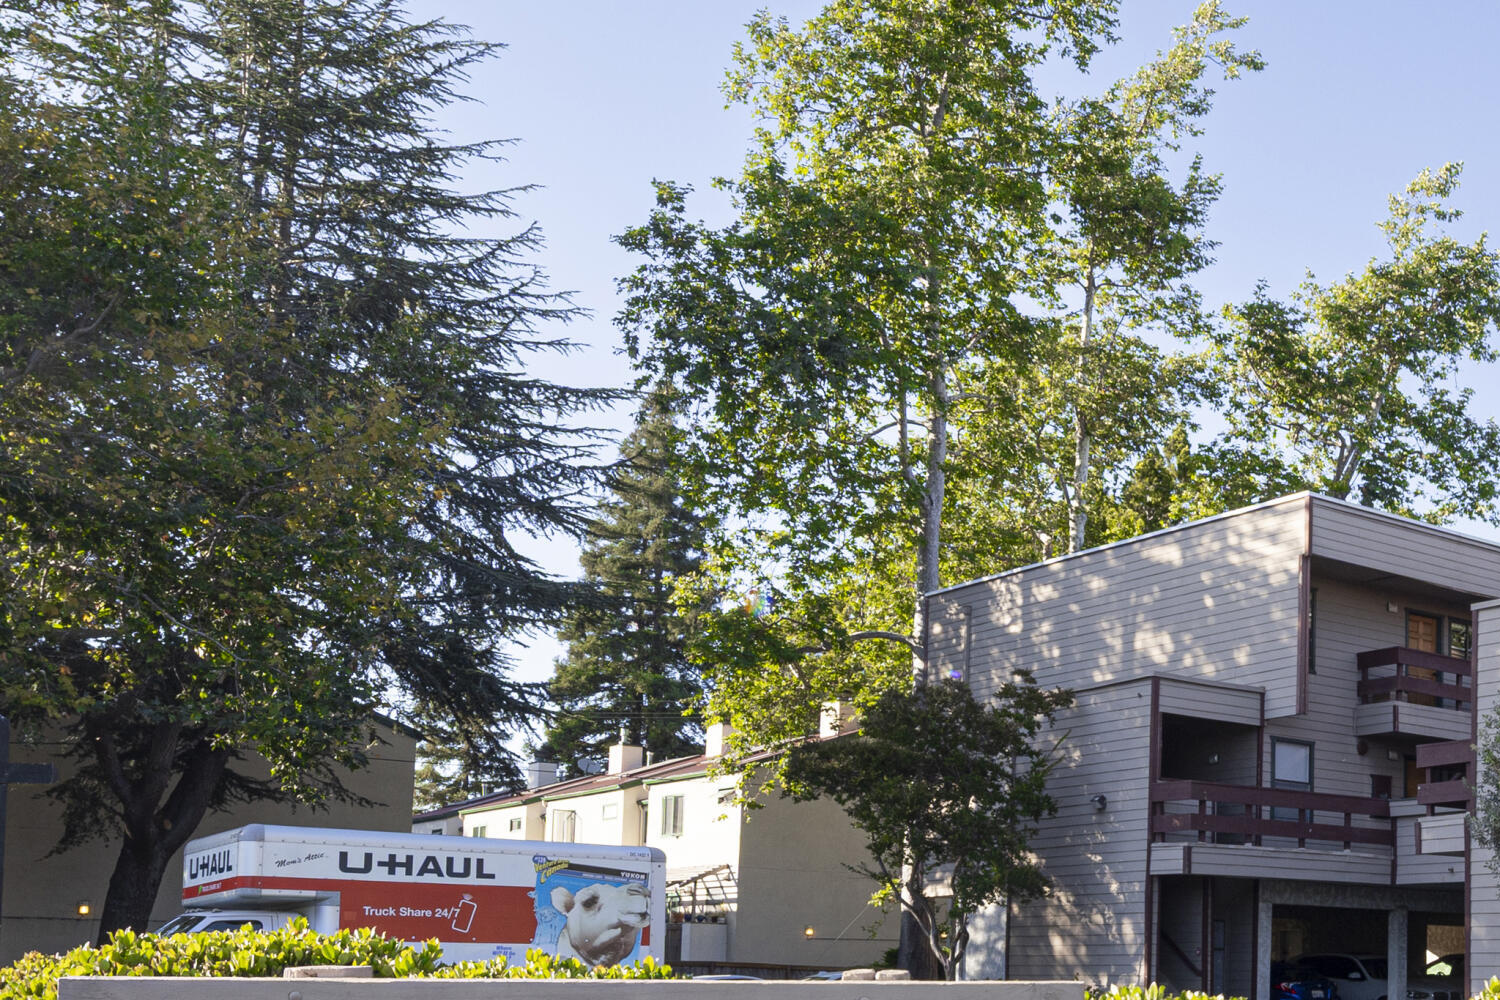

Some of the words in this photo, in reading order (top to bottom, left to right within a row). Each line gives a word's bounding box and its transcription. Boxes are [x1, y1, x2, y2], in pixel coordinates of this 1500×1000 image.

[304, 852, 325, 863] Attic
[620, 871, 646, 880] YUKON
[363, 905, 396, 917] Truck
[400, 906, 432, 918] Share
[435, 907, 460, 920] 24/7
